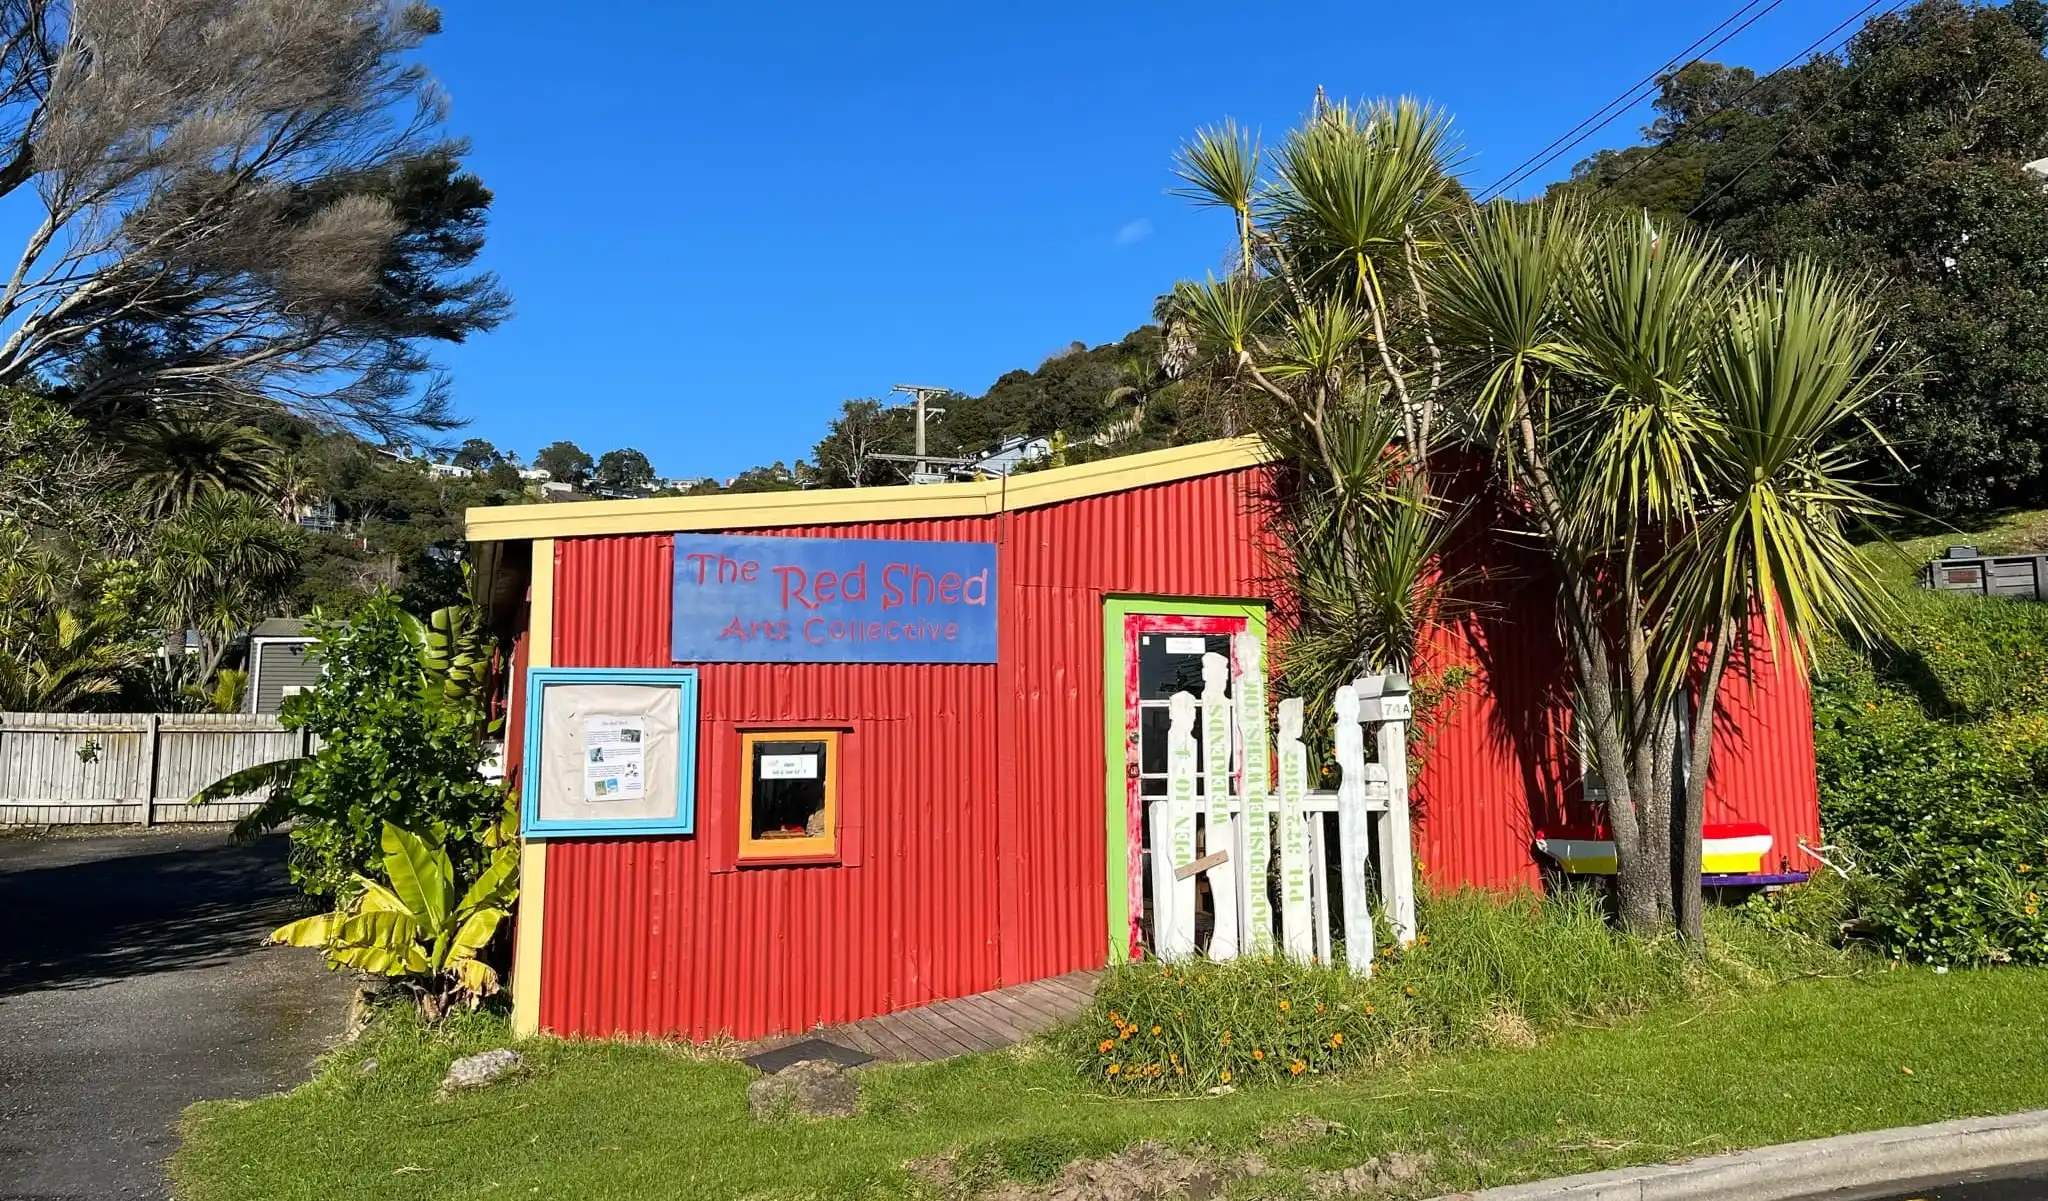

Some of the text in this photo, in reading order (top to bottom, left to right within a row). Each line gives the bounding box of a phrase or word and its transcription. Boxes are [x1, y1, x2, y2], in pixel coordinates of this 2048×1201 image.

[686, 553, 988, 611] The Red Shed
[719, 616, 959, 645] Arts Collective
[1208, 703, 1228, 825] WEEKENDS
